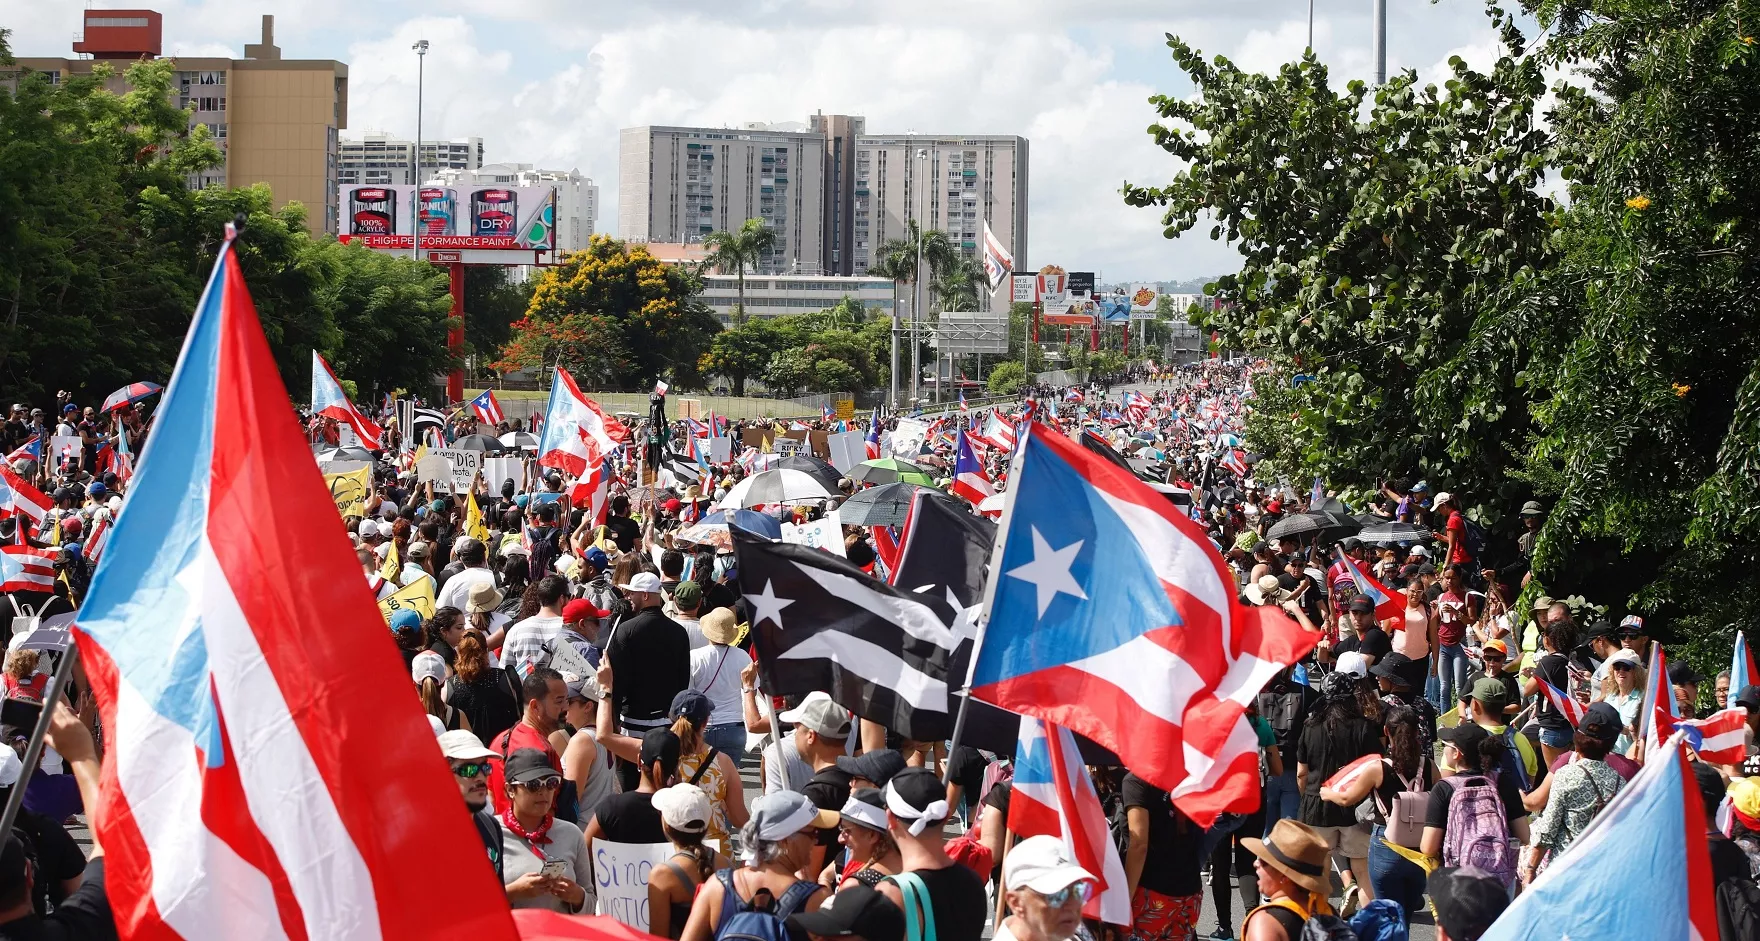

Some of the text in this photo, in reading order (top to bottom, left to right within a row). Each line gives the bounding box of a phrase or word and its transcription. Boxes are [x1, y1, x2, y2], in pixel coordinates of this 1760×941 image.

[354, 200, 391, 215] TITANIUM
[477, 200, 515, 216] TITANIUM
[480, 219, 512, 229] DRY
[372, 236, 399, 245] HIGH
[481, 237, 512, 246] PAINT
[456, 452, 476, 468] Día
